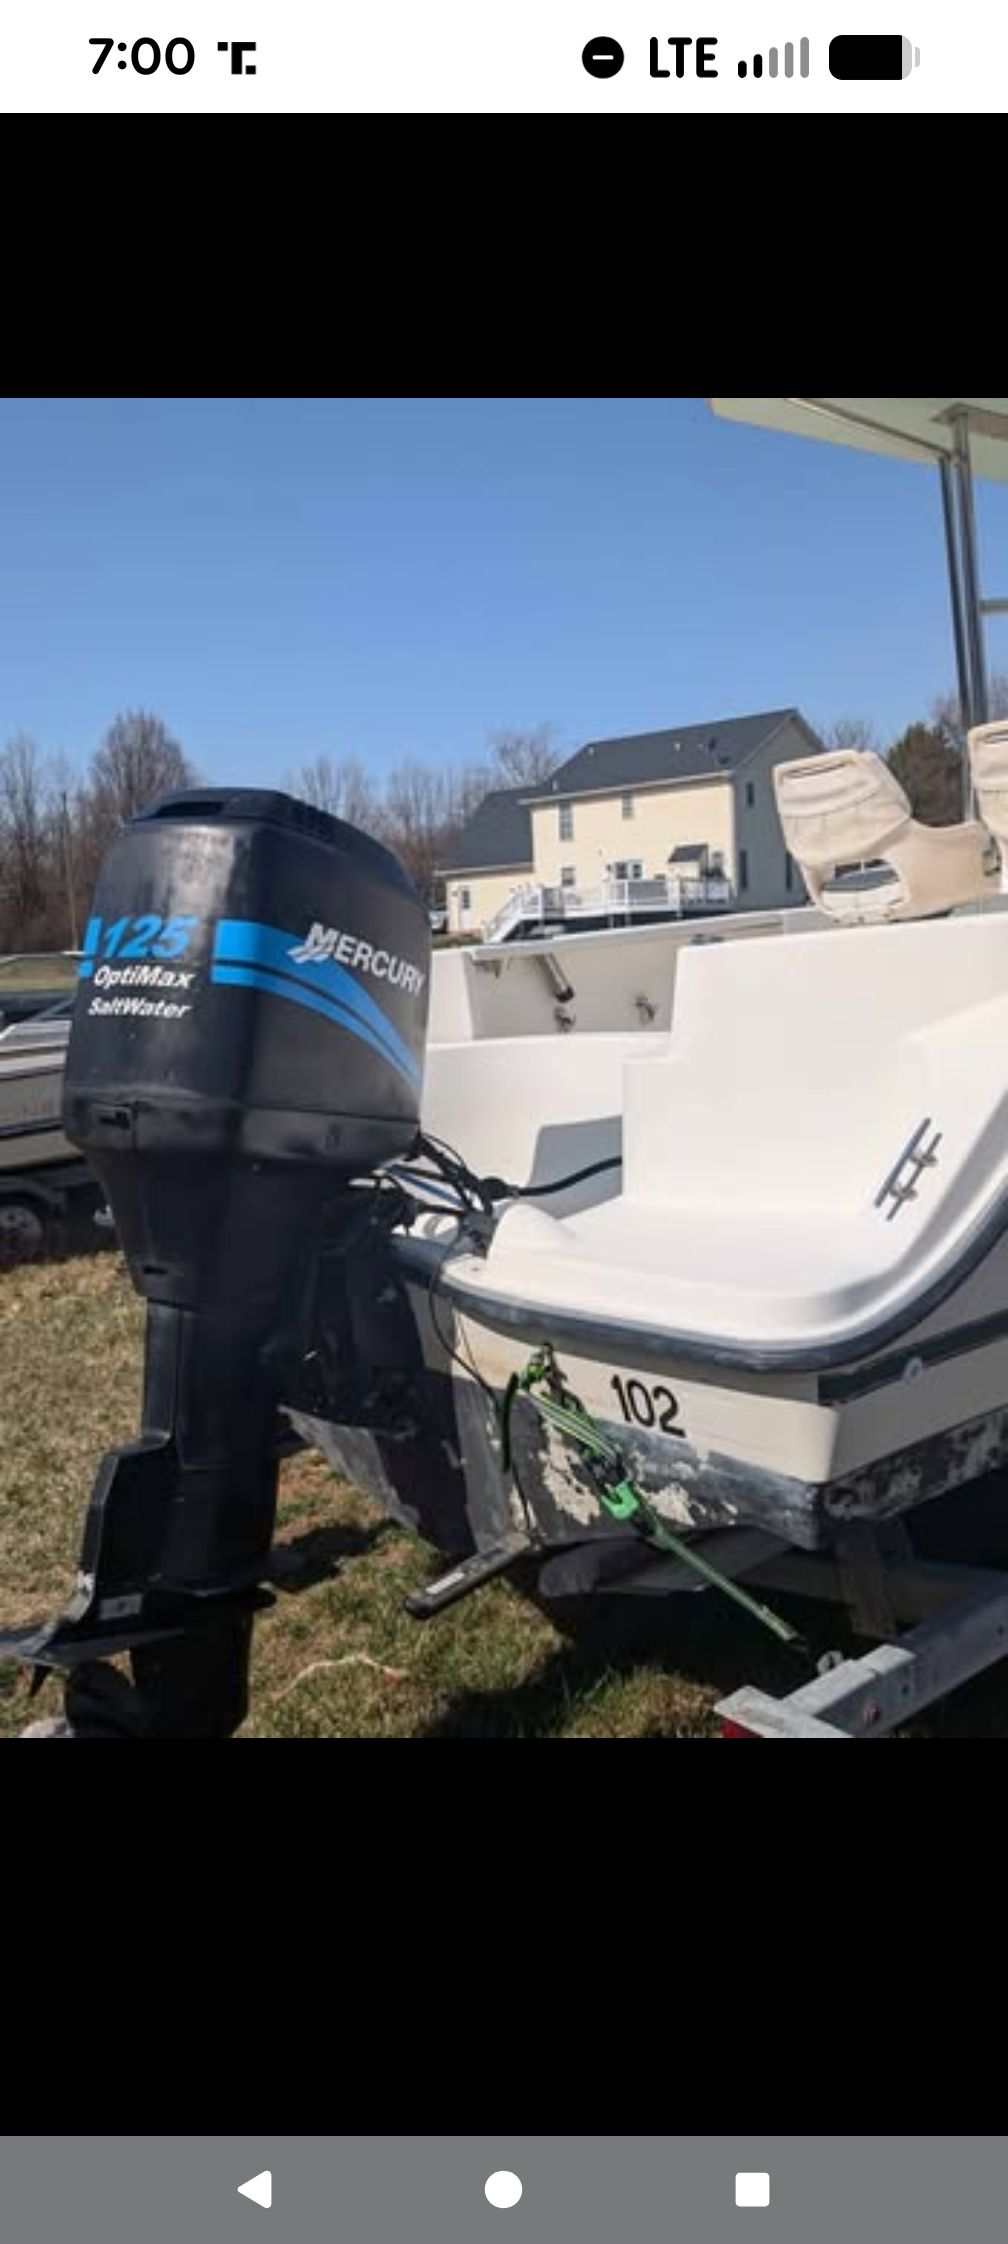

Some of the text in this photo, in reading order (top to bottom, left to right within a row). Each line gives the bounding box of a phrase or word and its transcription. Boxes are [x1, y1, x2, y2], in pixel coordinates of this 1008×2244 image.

[100, 916, 196, 958] 125
[93, 963, 196, 991] OptiMax
[287, 922, 425, 995] MERCURY
[87, 996, 193, 1020] SaltWater
[611, 1374, 686, 1438] 102
